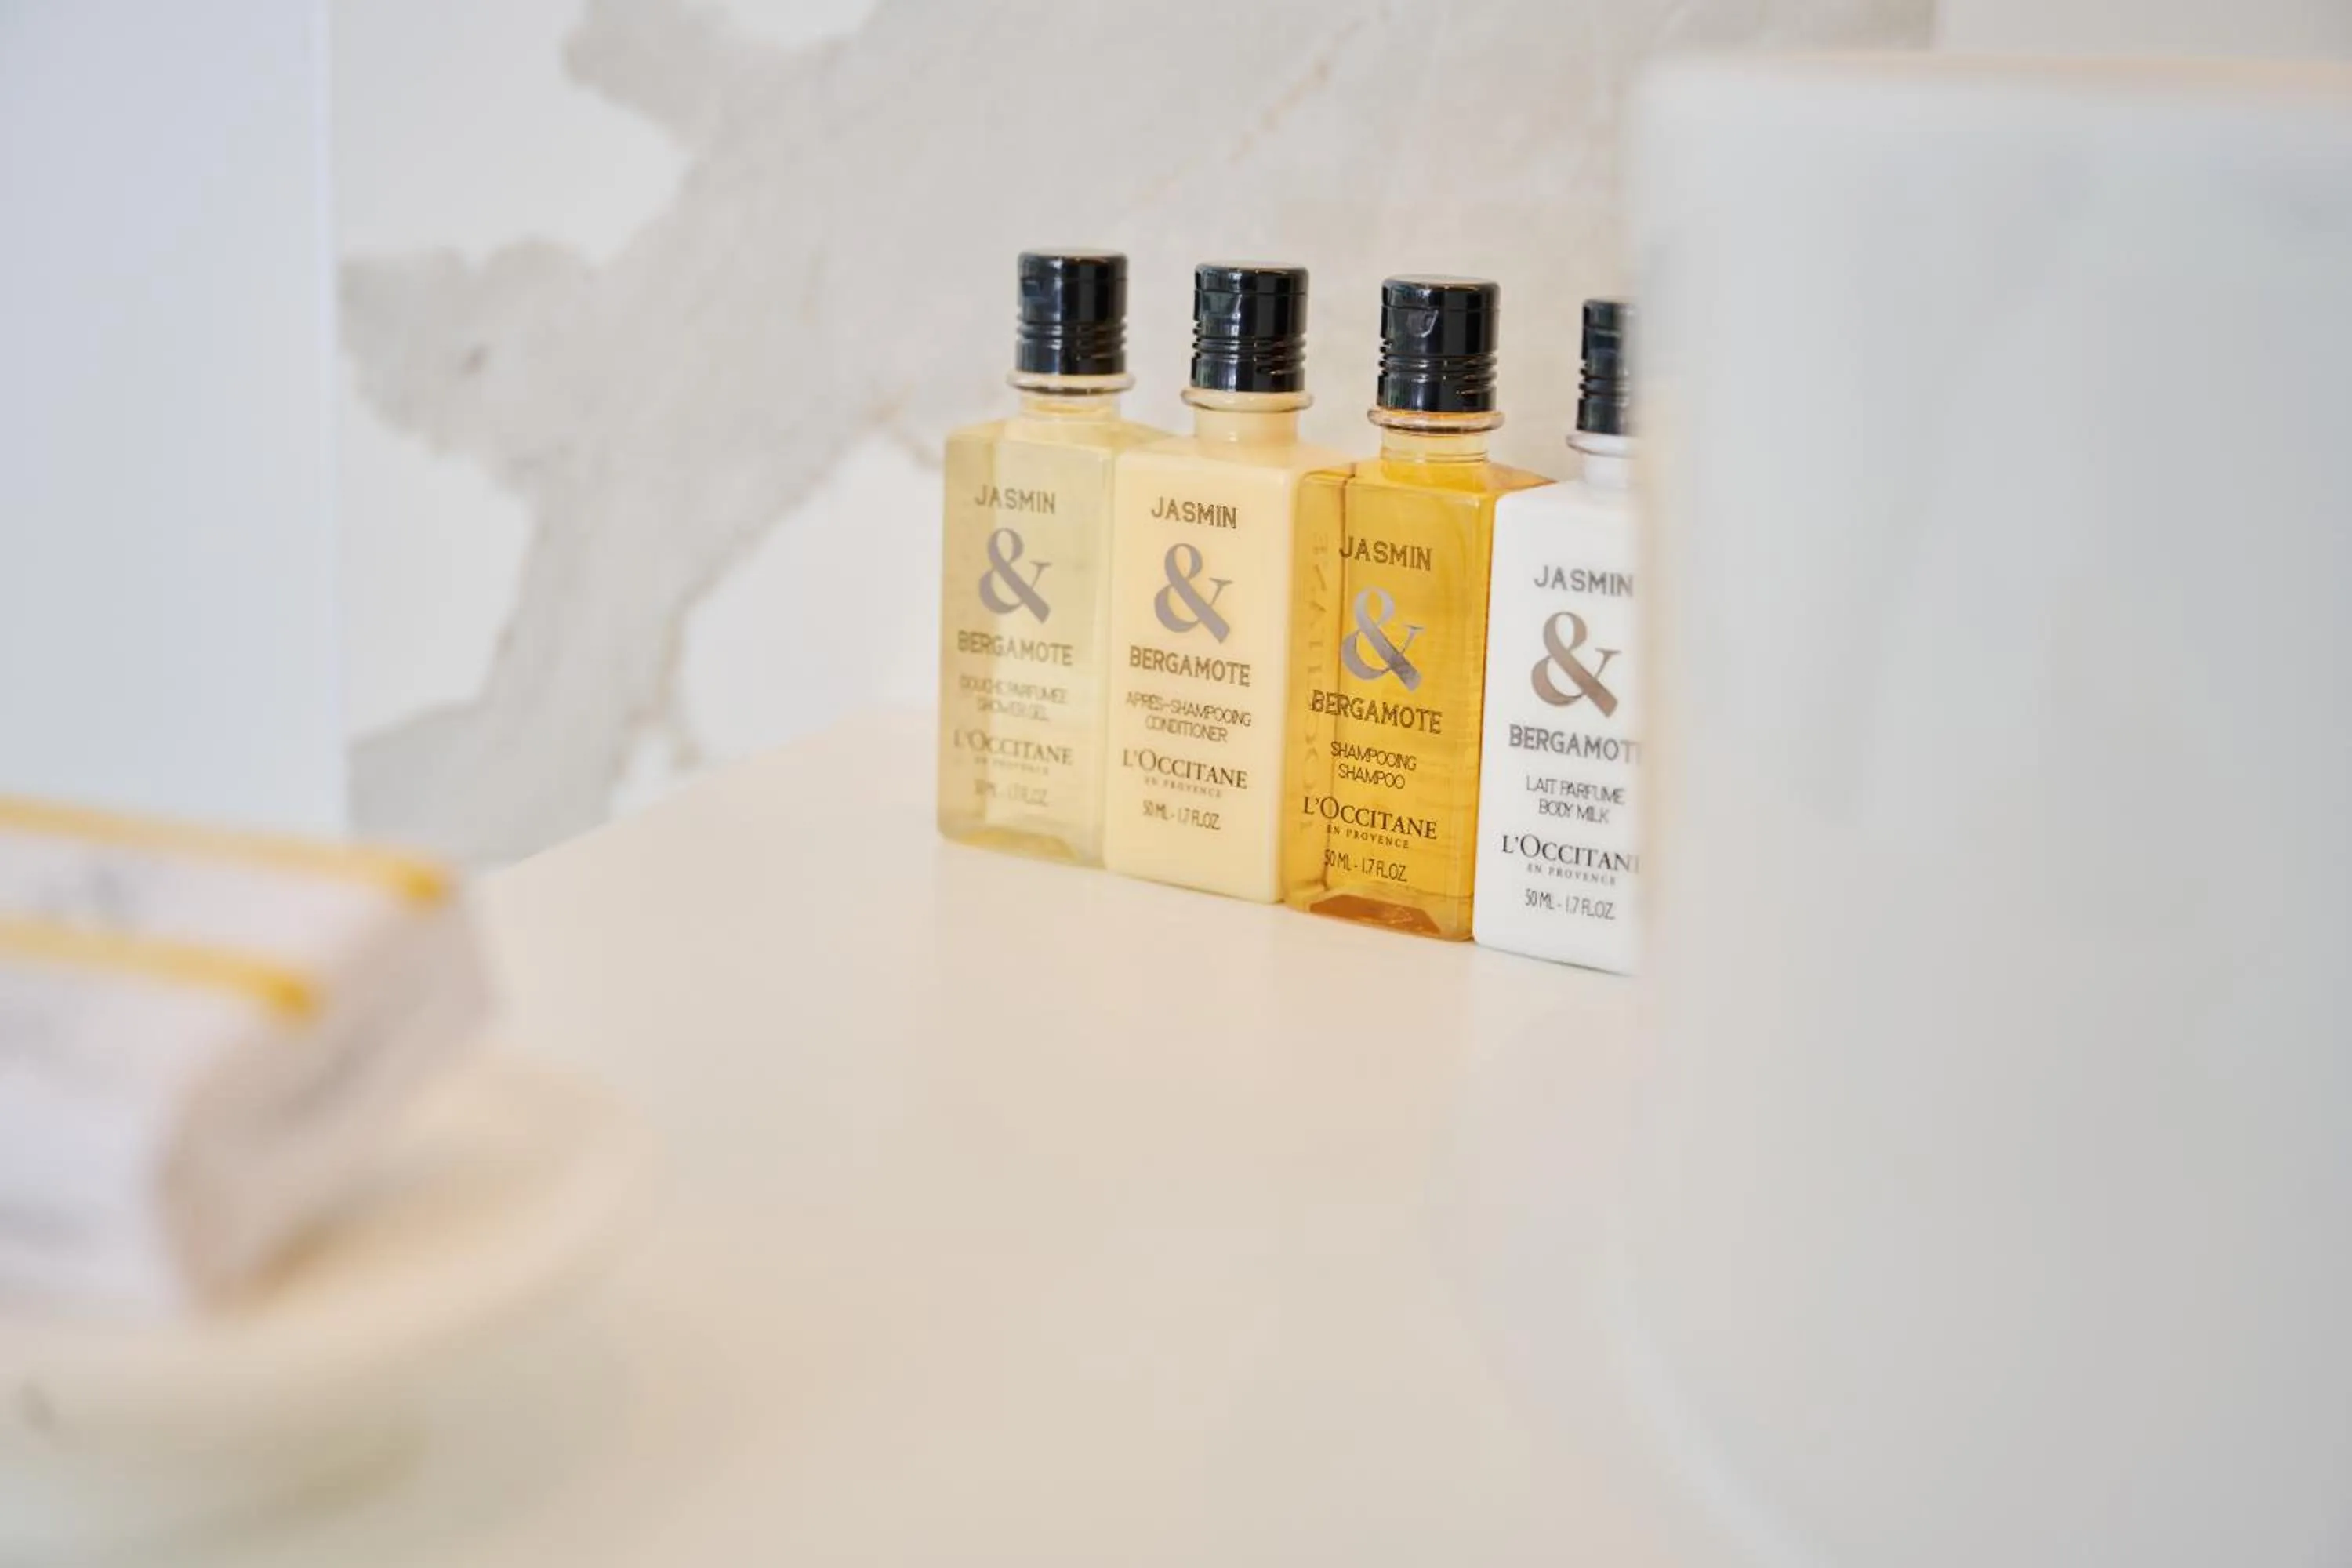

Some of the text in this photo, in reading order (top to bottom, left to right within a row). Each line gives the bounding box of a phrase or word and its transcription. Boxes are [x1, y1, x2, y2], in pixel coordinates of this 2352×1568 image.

[975, 485, 1056, 514] JASMIN
[1152, 496, 1236, 529] JASMIN
[1339, 536, 1432, 571] JASMIN
[979, 527, 1053, 624] &
[1534, 565, 1633, 597] JASMIN
[1154, 543, 1233, 644] &
[957, 630, 1073, 666] BERGAMOTE
[1341, 586, 1425, 691] &
[1129, 645, 1250, 687] BERGAMOTE
[1531, 611, 1622, 718] &
[1145, 715, 1228, 742] CONDITIONER
[1311, 689, 1443, 734] BERGAMOTE
[1123, 749, 1247, 789] L'OCCITANE
[1330, 741, 1417, 771] SHAMPOOING
[1338, 763, 1406, 789] SHAMPOO
[1526, 775, 1557, 794] LAIT
[1303, 796, 1437, 840] L'OCCITANE
[1538, 798, 1610, 823] BODY MILK
[1327, 824, 1410, 849] EN PROVENCE
[1527, 863, 1616, 886] EN PROVENCE
